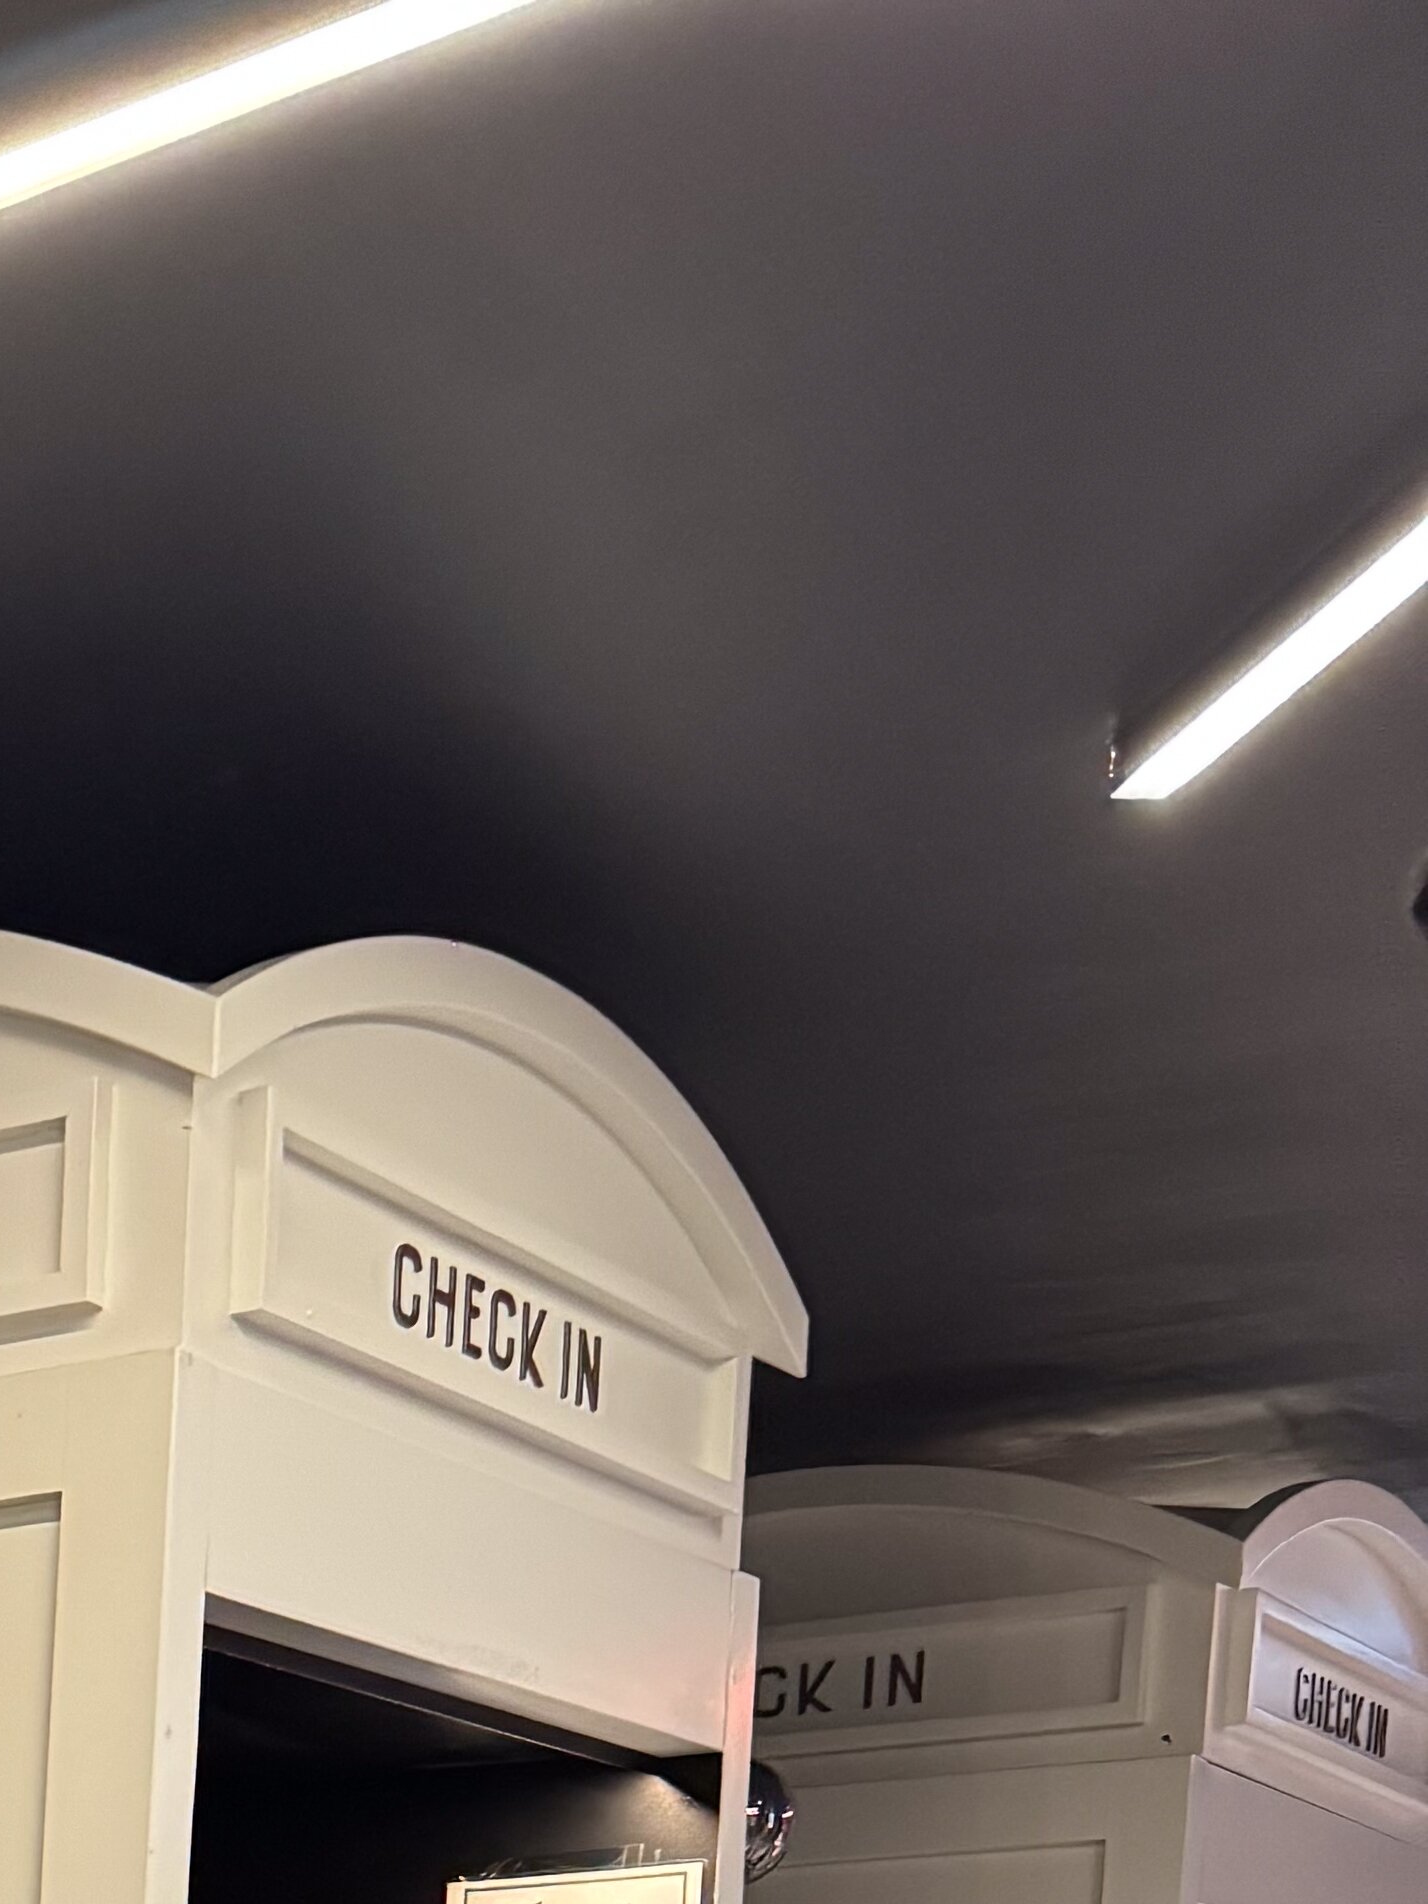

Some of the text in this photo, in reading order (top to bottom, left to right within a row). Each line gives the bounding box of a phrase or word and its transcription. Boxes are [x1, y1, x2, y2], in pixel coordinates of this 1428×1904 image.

[391, 1243, 602, 1413] CHECK IN
[861, 1650, 925, 1710] IN
[1294, 1667, 1389, 1758] CHECK IN
